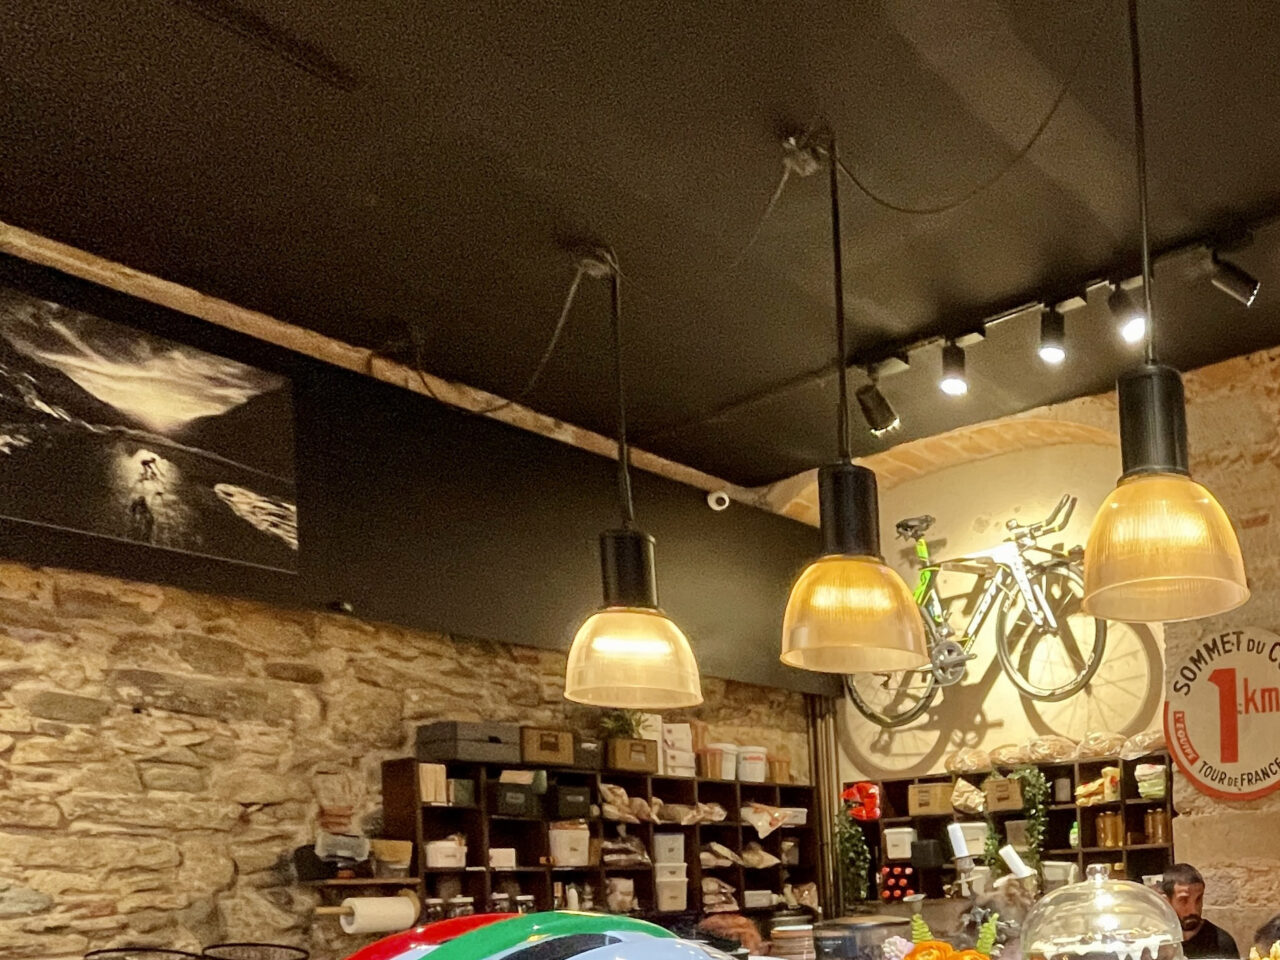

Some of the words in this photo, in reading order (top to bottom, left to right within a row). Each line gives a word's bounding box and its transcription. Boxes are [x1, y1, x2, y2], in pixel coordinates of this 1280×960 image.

[1173, 630, 1244, 697] SOMMET
[1247, 639, 1266, 655] DU
[1208, 667, 1238, 763] 1
[1243, 677, 1280, 715] km
[1199, 761, 1227, 786] TOUR
[1228, 776, 1239, 787] DE
